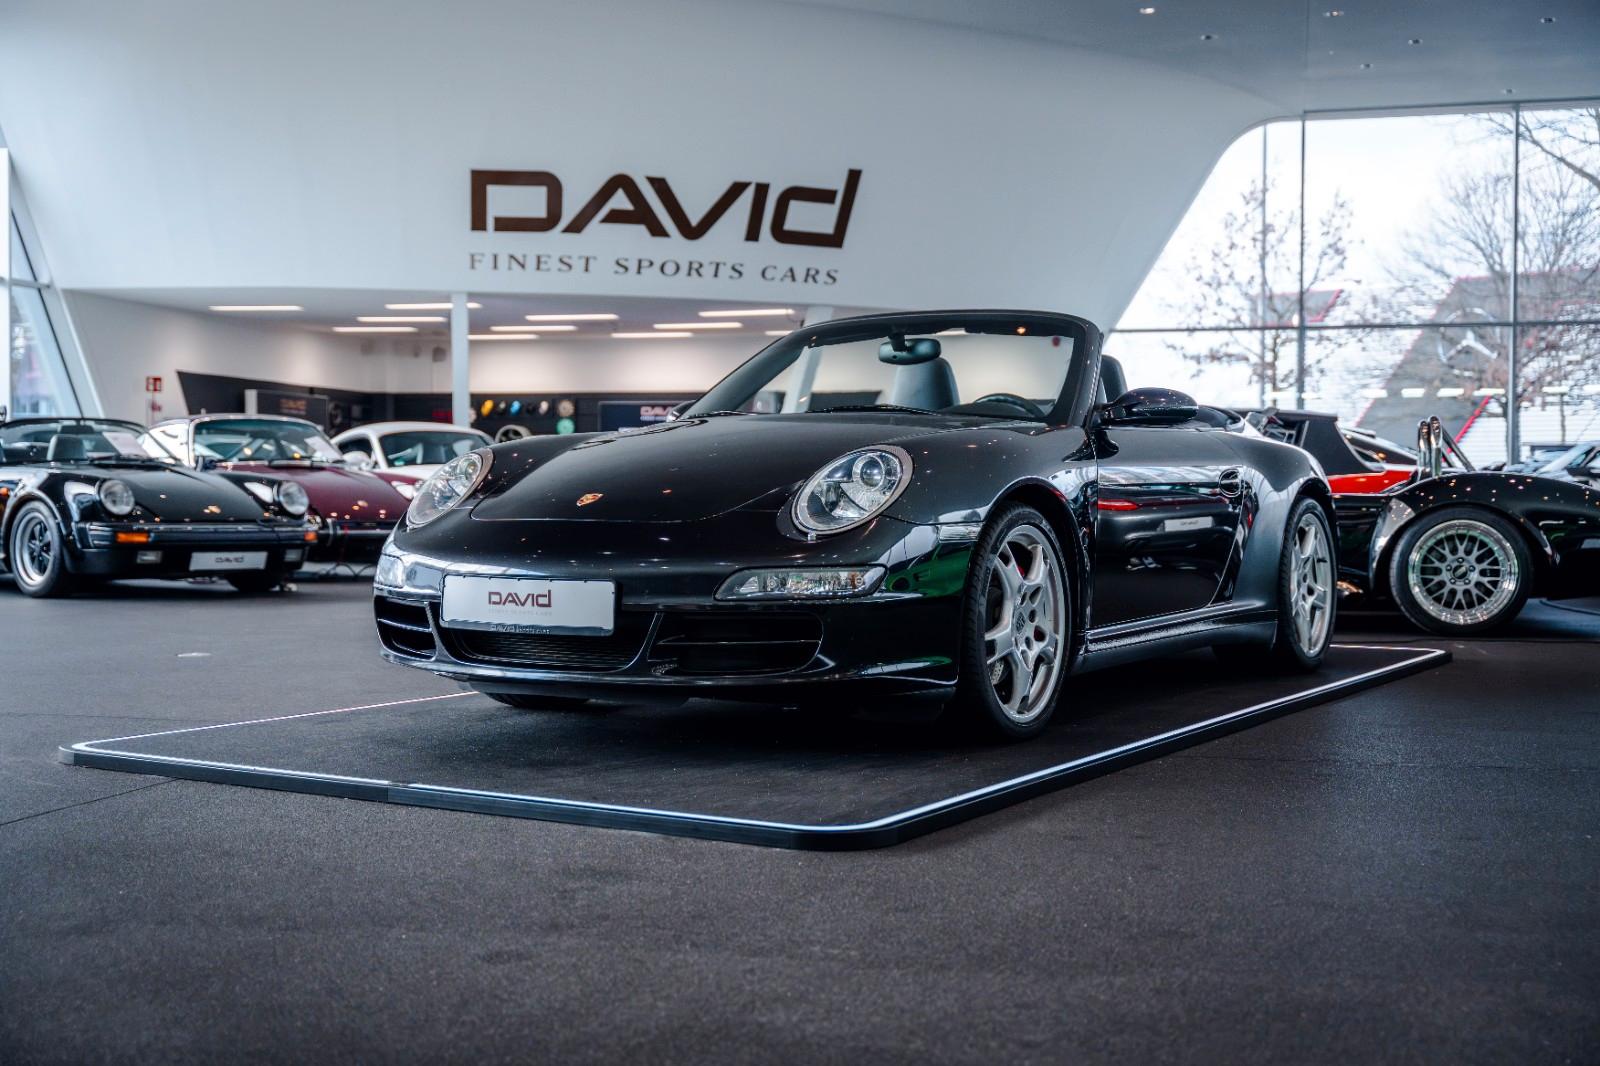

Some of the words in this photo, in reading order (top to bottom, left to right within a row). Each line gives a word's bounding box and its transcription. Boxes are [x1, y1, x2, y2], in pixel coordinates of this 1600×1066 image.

[468, 252, 598, 273] FINEST
[613, 257, 745, 280] SPORTS
[760, 264, 840, 286] CARS
